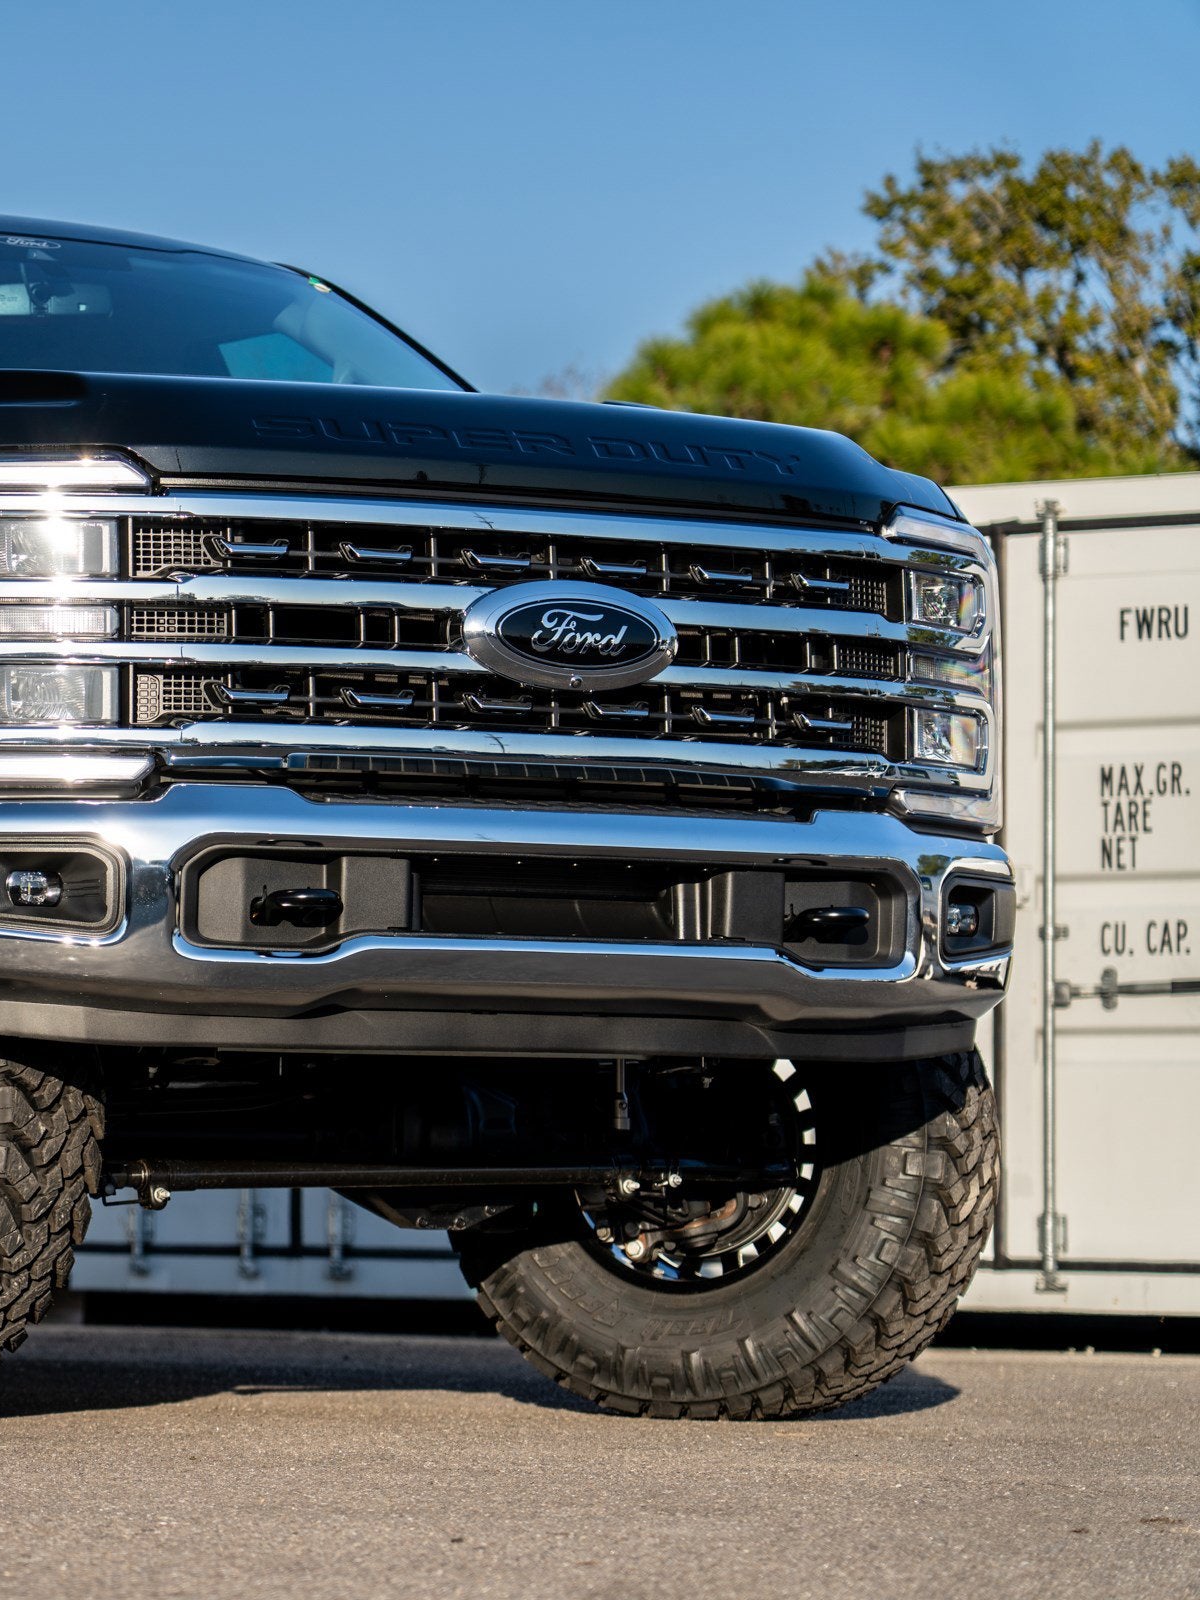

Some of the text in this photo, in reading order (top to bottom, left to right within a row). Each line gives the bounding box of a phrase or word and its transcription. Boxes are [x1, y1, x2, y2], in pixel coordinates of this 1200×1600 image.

[6, 236, 50, 248] Ford
[250, 413, 801, 476] SUPER DUTY
[531, 608, 629, 657] Ford
[1119, 604, 1189, 642] FWRU
[1101, 798, 1153, 834] TARE
[1101, 835, 1138, 870] NET
[1100, 918, 1191, 957] CU. CAP.
